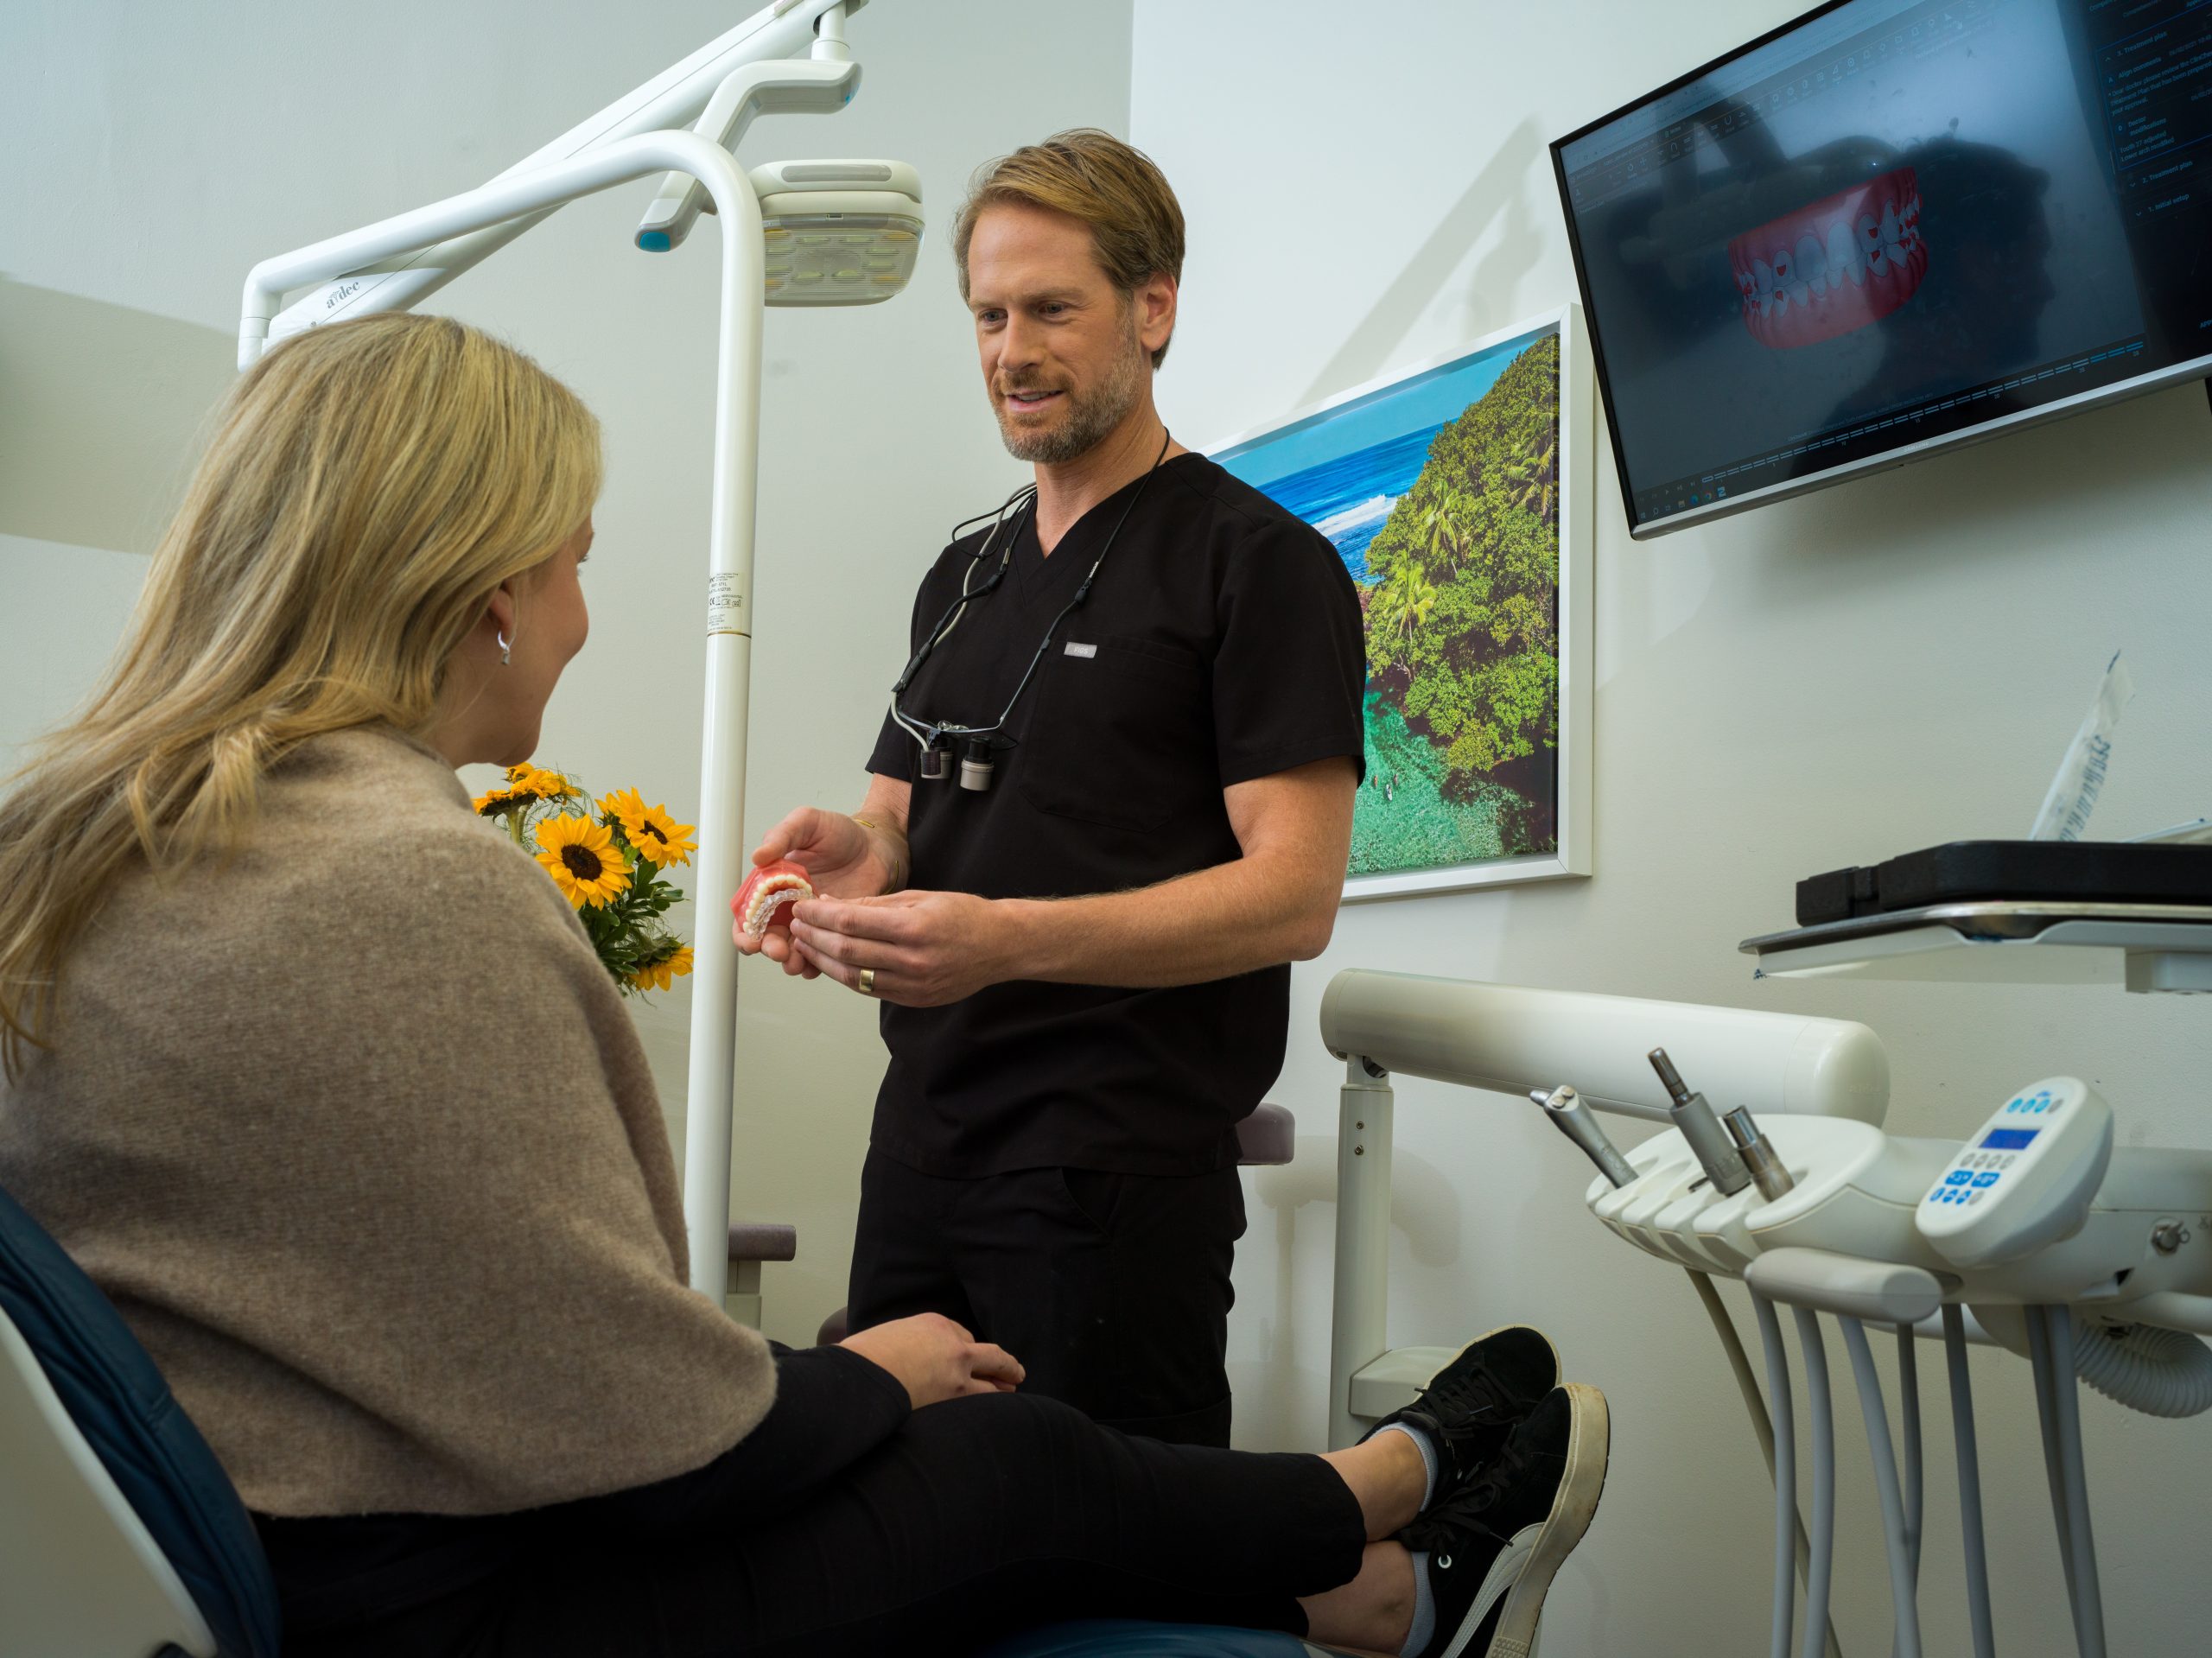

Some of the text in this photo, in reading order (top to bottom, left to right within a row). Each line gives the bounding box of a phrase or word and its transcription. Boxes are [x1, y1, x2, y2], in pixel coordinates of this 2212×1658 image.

[2125, 36, 2152, 54] Treatment
[2150, 166, 2178, 180] Treatment
[2179, 161, 2193, 170] plan
[2155, 200, 2171, 210] Initial
[2172, 194, 2190, 204] setup
[1073, 646, 1089, 655] FIGS
